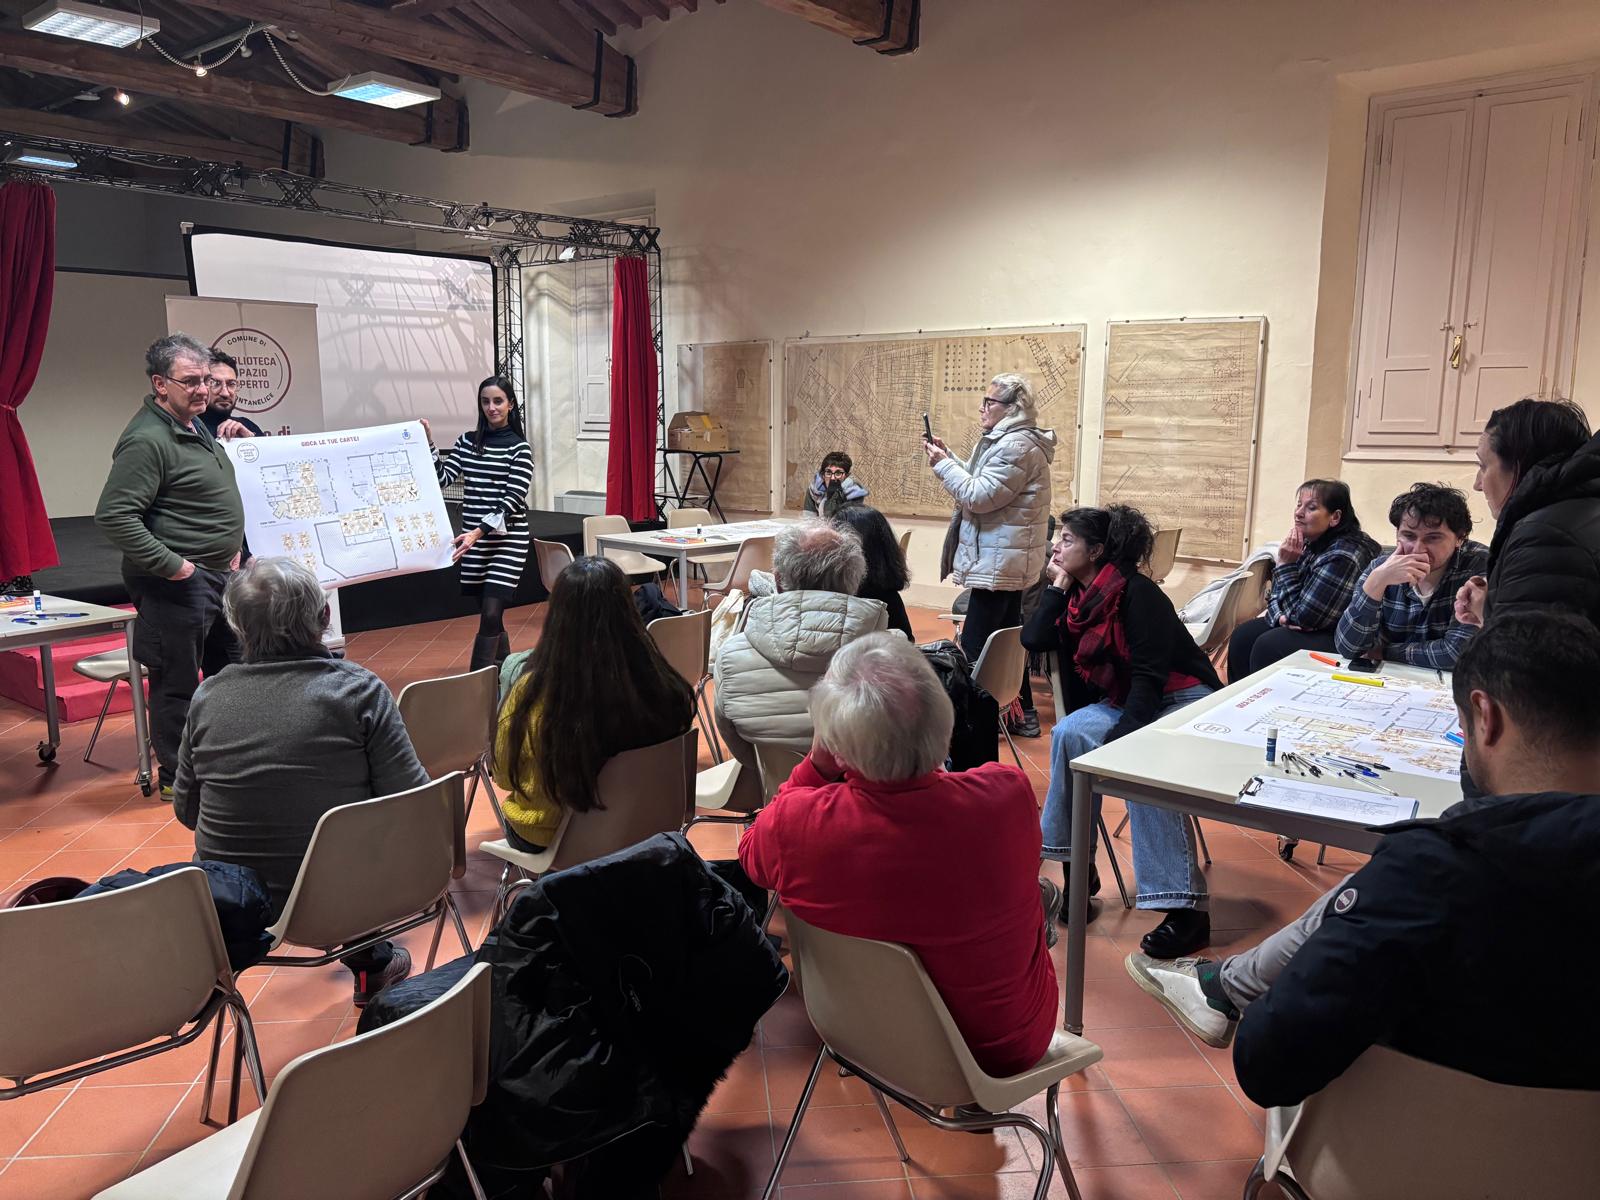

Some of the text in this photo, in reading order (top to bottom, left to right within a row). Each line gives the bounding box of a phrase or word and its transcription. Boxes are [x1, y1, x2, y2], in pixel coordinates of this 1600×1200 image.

[227, 336, 258, 345] COMUNE
[239, 368, 268, 378] PAZIO
[239, 380, 270, 389] PERTO
